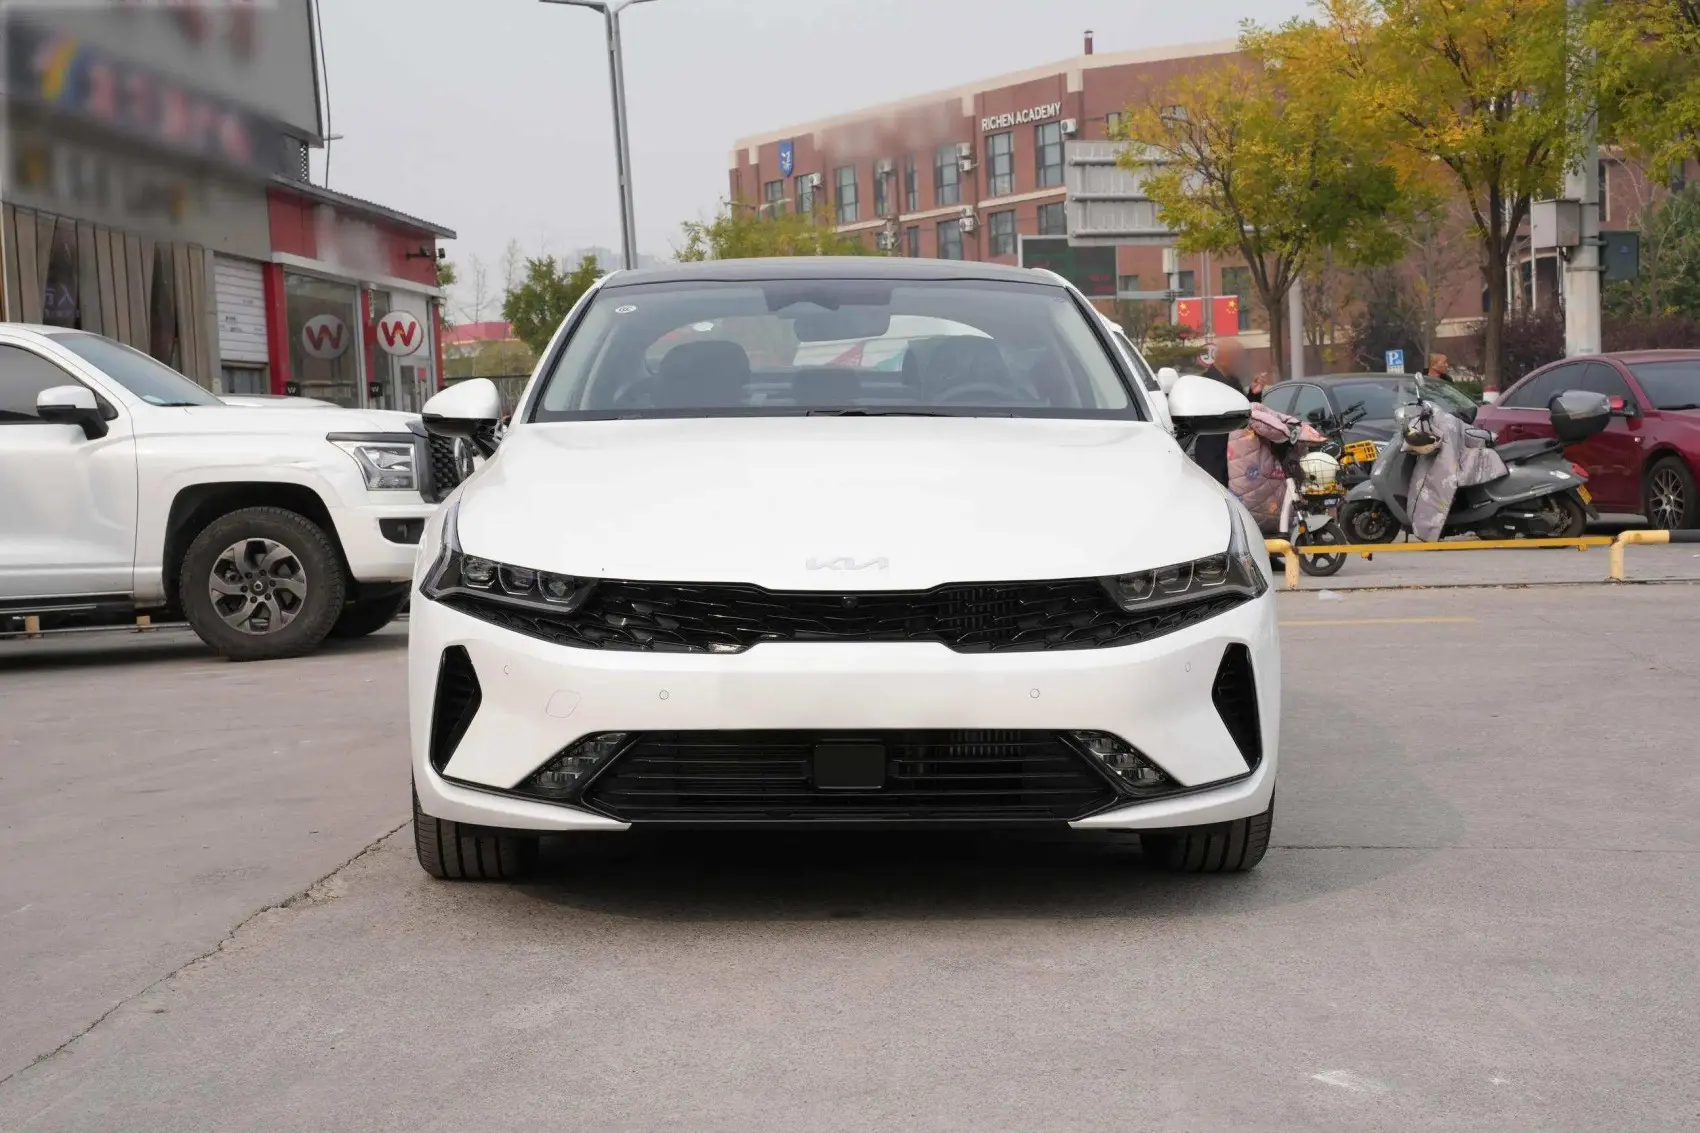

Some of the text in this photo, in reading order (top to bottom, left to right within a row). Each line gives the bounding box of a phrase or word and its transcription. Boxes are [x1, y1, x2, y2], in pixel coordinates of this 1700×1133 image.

[982, 102, 1061, 131] RICHEN ACADEMY
[381, 320, 416, 347] W
[1388, 351, 1399, 365] P
[805, 556, 889, 571] KIA
